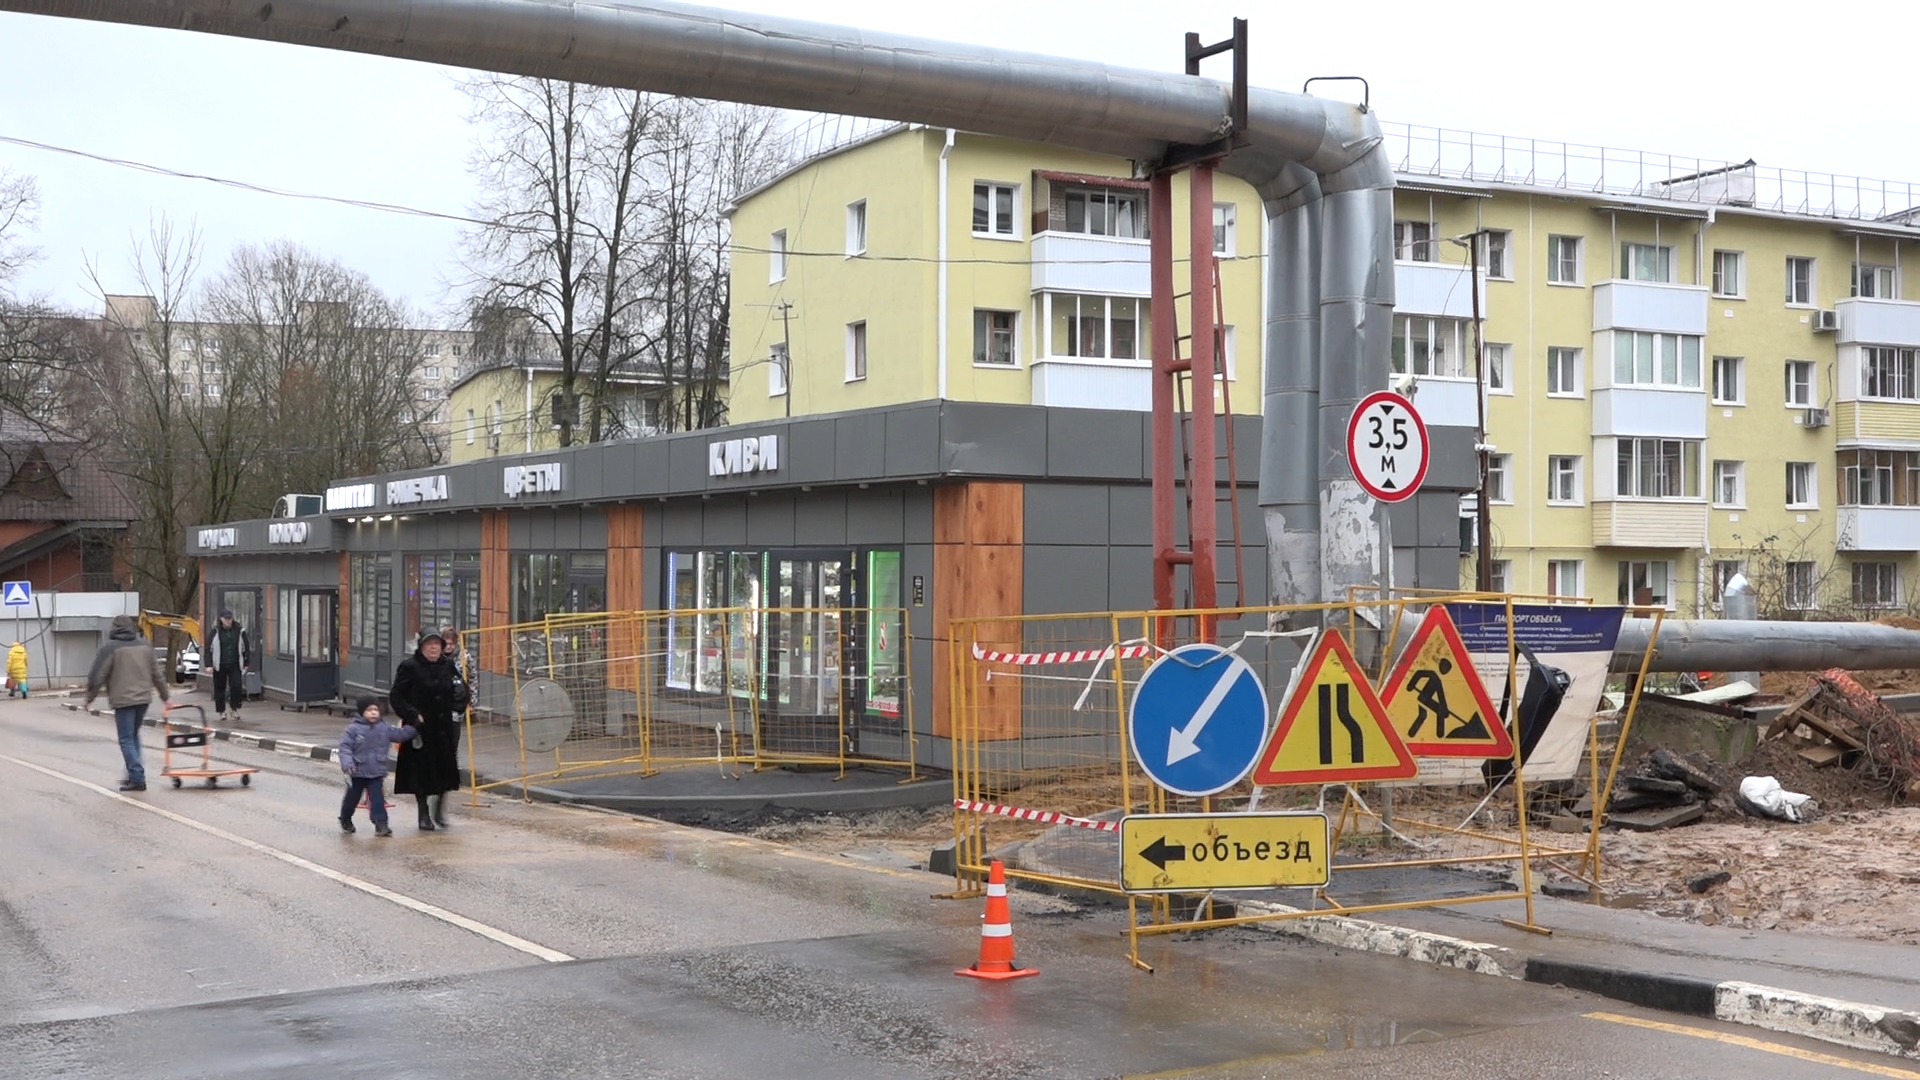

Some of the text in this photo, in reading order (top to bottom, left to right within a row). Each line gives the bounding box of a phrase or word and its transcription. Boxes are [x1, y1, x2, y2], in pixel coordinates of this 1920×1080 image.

[1368, 416, 1408, 454] 3,5
[709, 435, 778, 476] КИВИ
[504, 462, 561, 498] ЦВЕТЫ
[1530, 614, 1562, 623] ОБЪЕКТА
[1192, 835, 1312, 863] объезд
